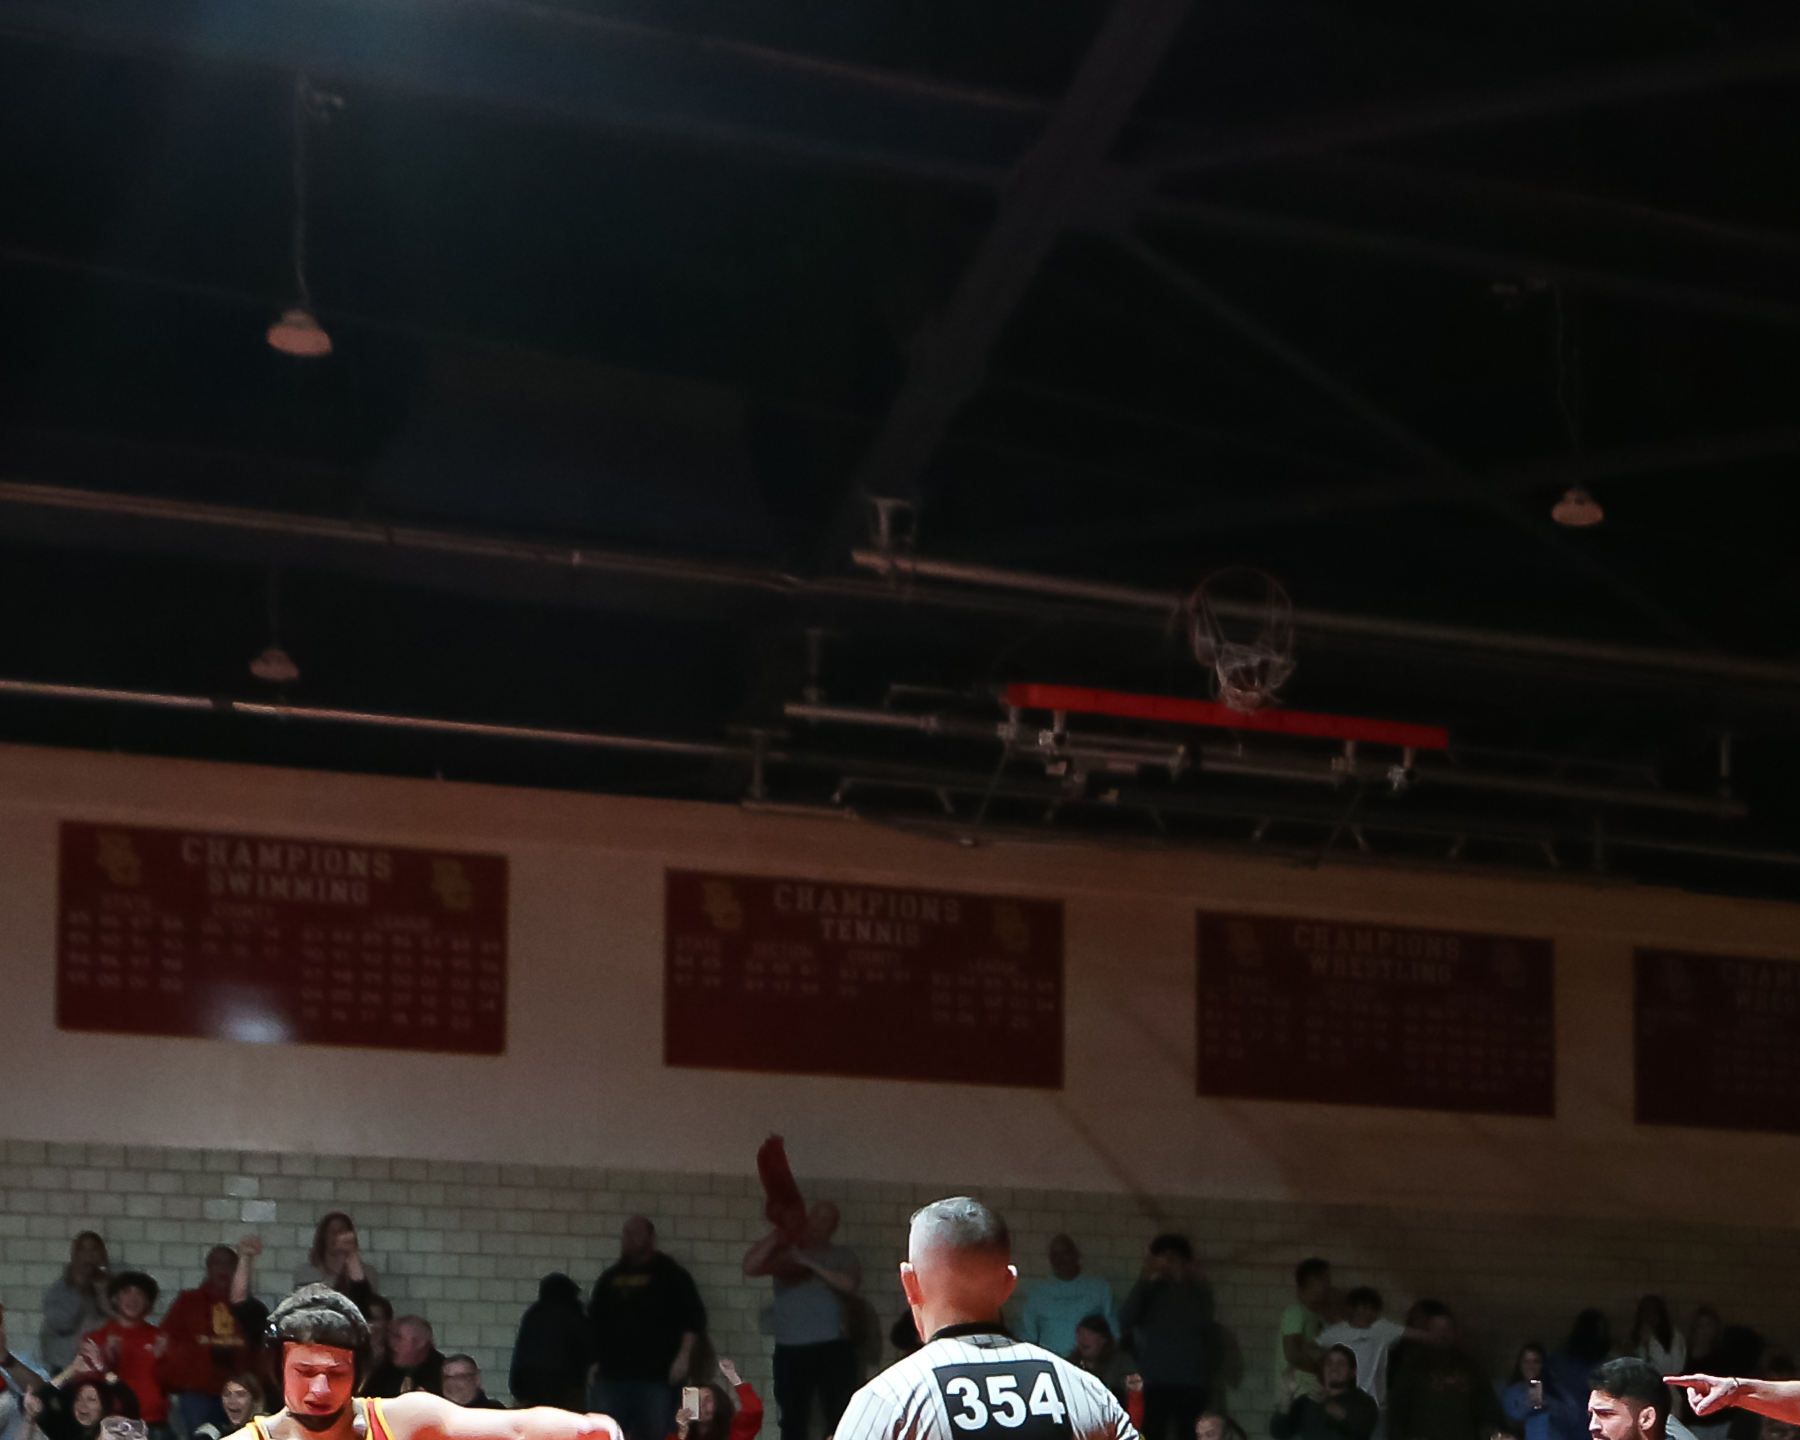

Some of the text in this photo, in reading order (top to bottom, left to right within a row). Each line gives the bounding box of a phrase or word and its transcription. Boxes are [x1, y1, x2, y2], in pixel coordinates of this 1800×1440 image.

[181, 836, 393, 882] CHAMPIONS
[207, 868, 370, 907] SWIMMING
[773, 884, 961, 924] CHAMPIONS
[820, 917, 921, 947] TENNIS
[1294, 925, 1460, 962] CHAMPIONS
[1309, 953, 1452, 984] WRESTLING
[943, 1368, 1068, 1431] 354
